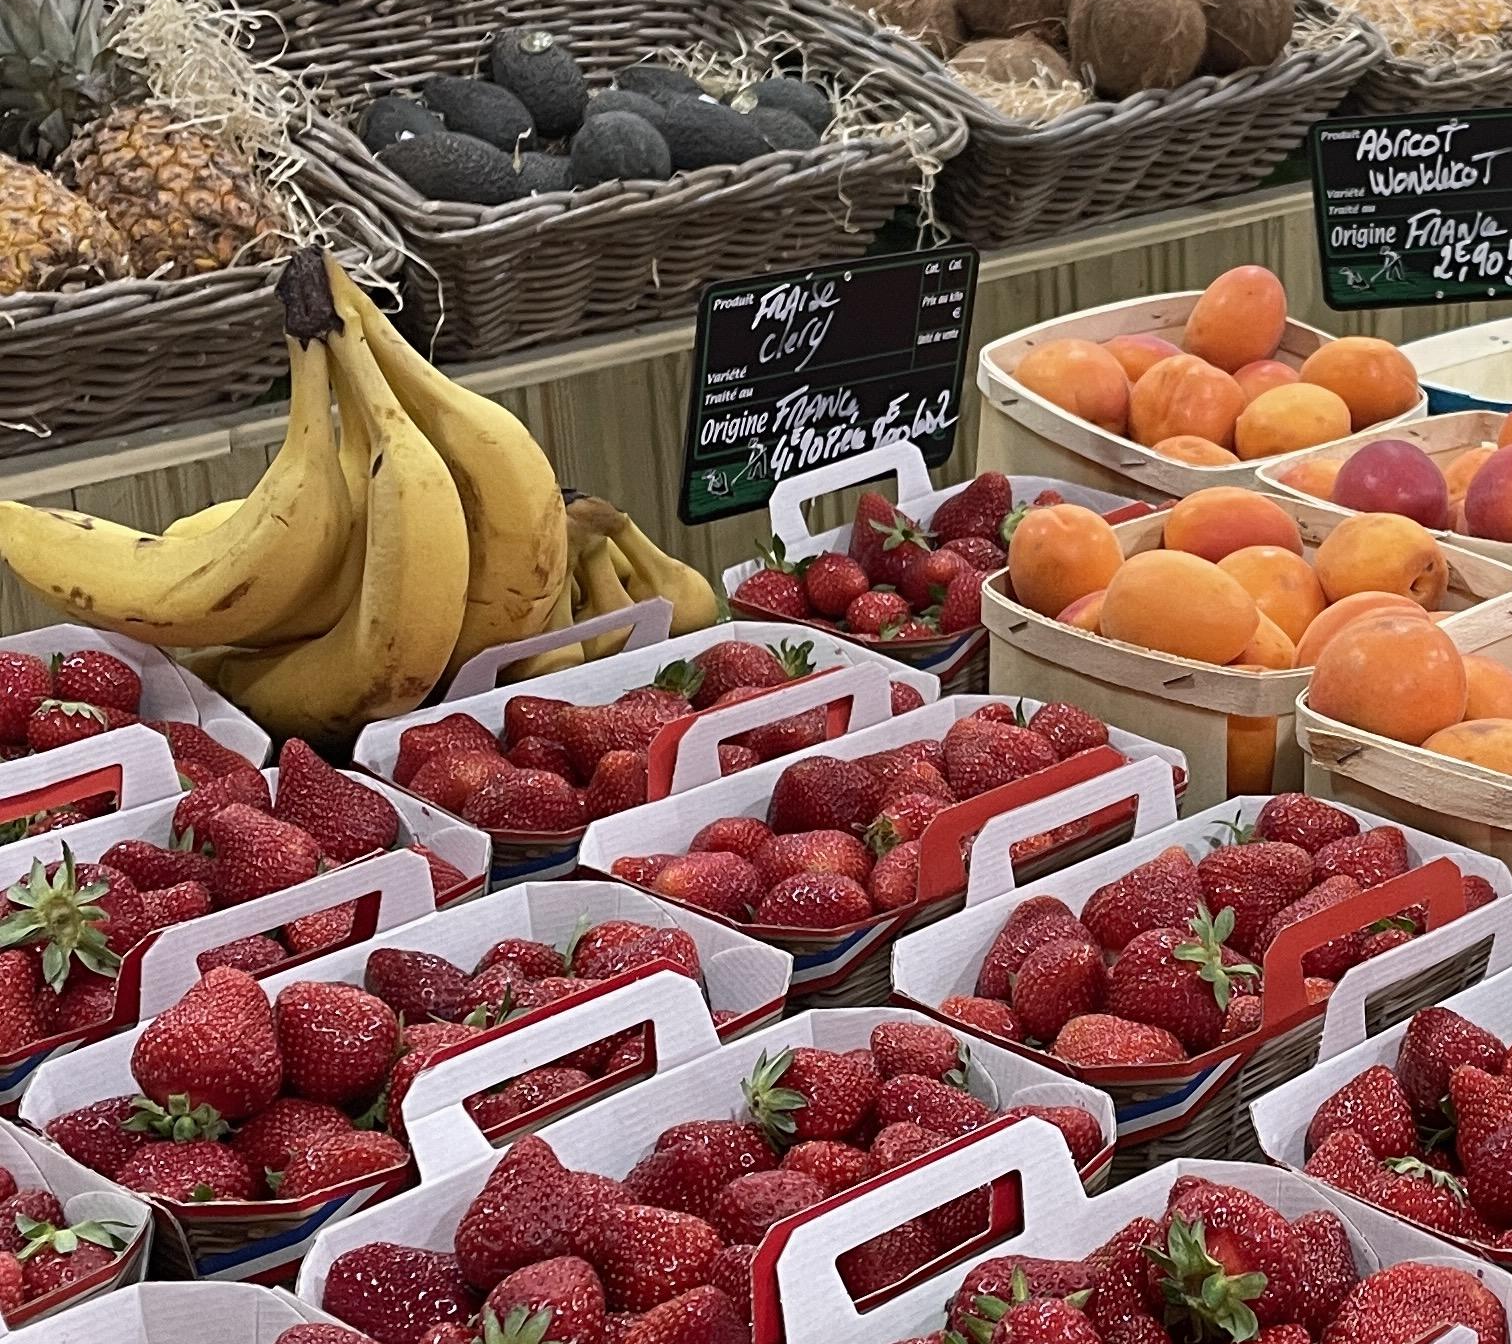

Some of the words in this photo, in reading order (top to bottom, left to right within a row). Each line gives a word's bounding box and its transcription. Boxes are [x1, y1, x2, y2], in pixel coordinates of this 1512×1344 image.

[1331, 222, 1397, 248] Origine
[713, 294, 754, 311] Produit
[707, 365, 747, 384] Variété
[704, 390, 737, 405] Traité
[739, 387, 754, 398] au
[701, 409, 769, 446] Origine
